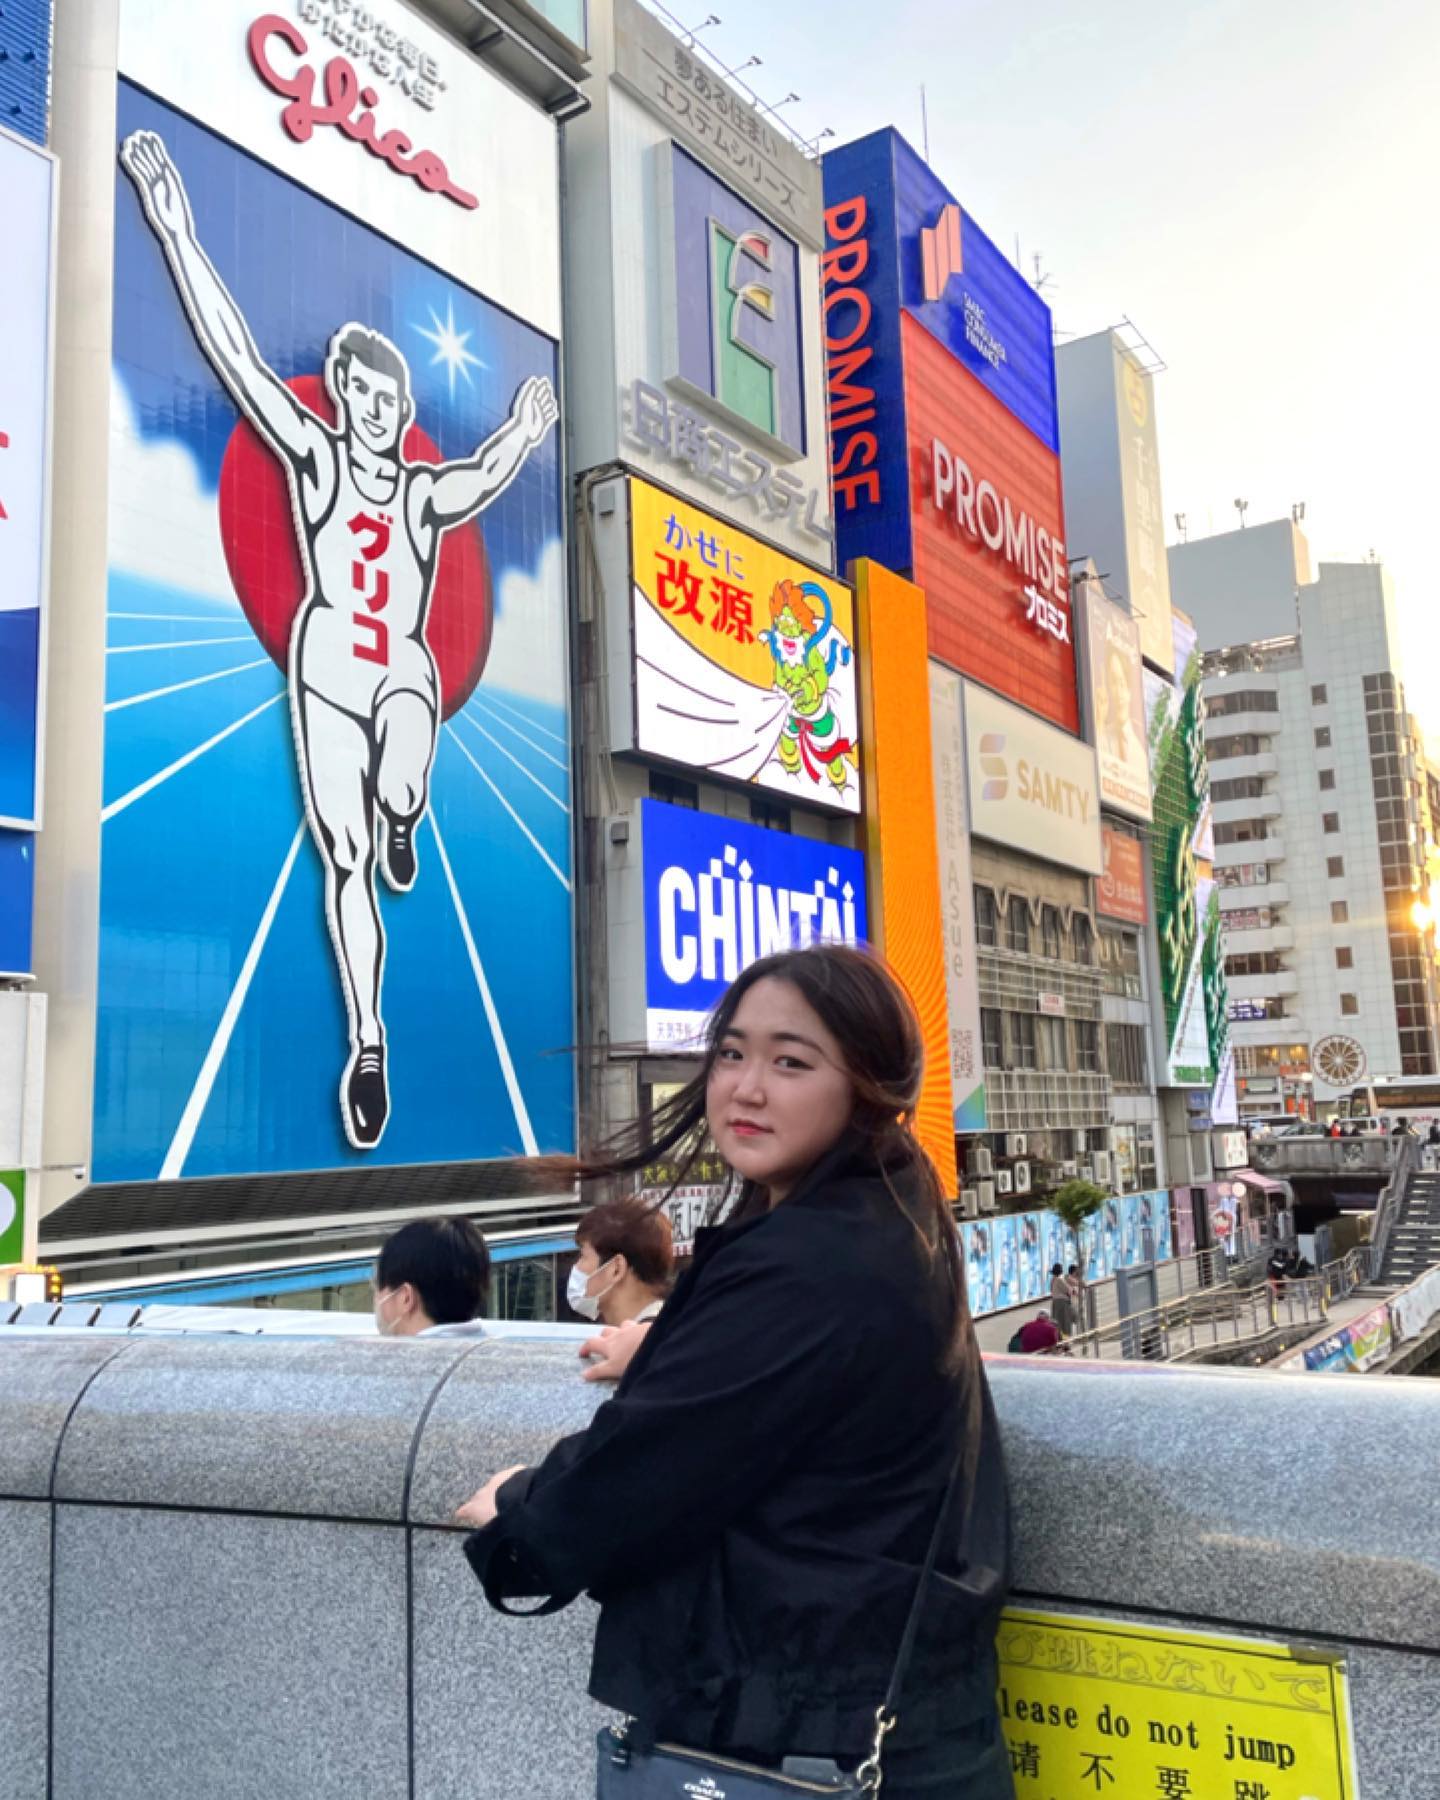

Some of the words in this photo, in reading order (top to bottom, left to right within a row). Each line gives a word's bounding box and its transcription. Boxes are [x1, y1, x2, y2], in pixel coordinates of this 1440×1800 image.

[248, 13, 479, 210] Glico
[657, 75, 796, 215] エステムシリーズ
[820, 195, 880, 511] PROMISE
[663, 513, 746, 580] かぜに
[932, 437, 1068, 603] PROMISE
[347, 511, 394, 668] グリコ
[654, 551, 754, 645] 改源
[1016, 759, 1089, 825] SAMTY
[1001, 1630, 1327, 1709] び跳ねないで
[1001, 1688, 1078, 1729] lease
[1098, 1704, 1130, 1738] do
[1149, 1719, 1199, 1749] not
[1225, 1725, 1295, 1770] jump
